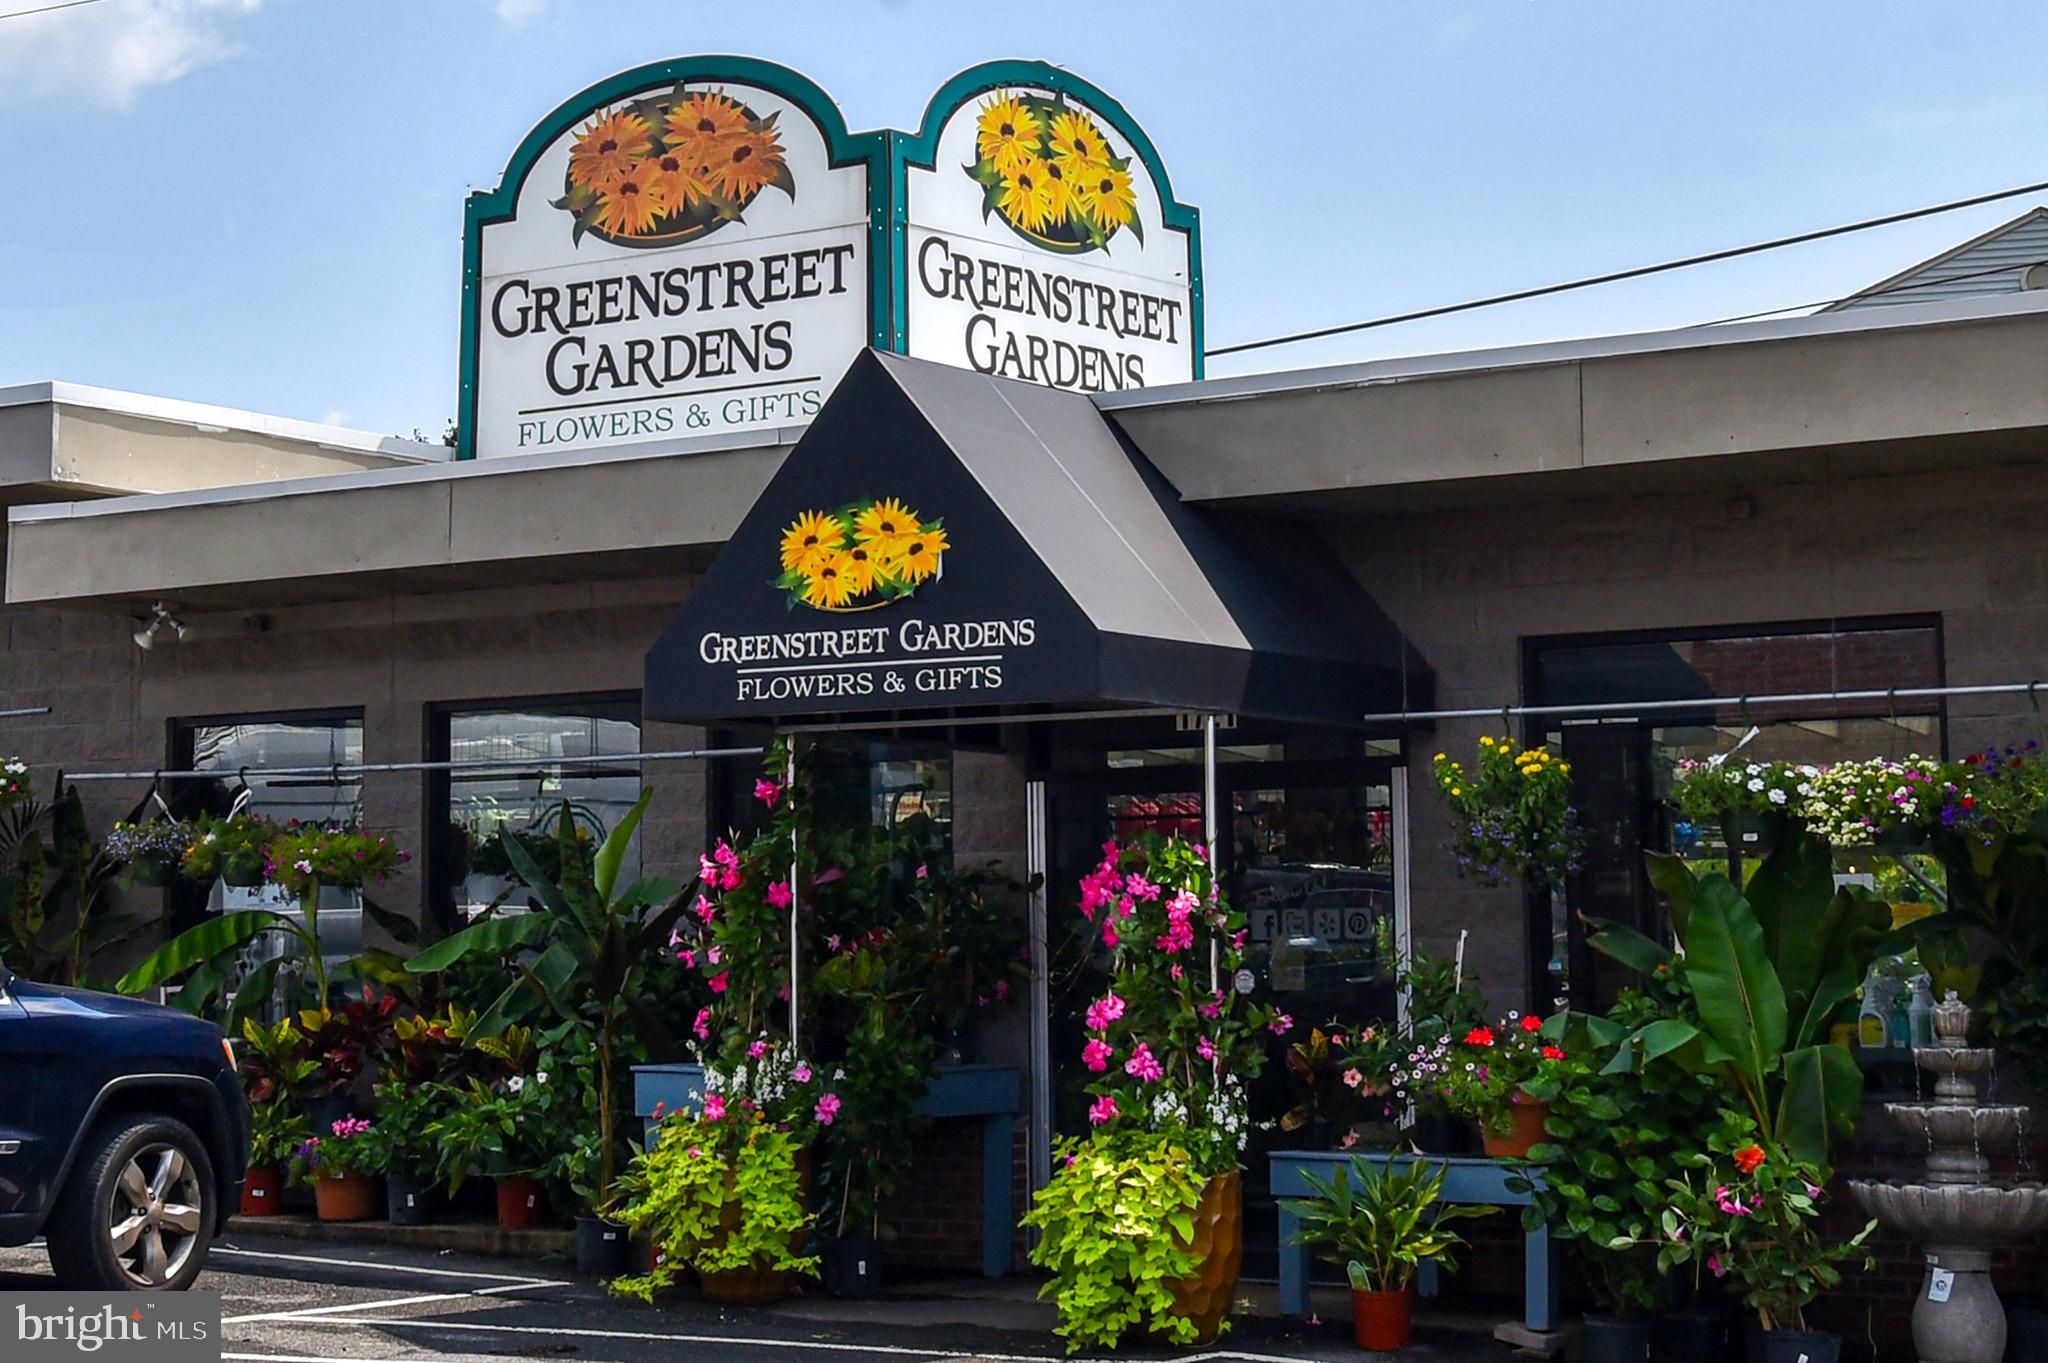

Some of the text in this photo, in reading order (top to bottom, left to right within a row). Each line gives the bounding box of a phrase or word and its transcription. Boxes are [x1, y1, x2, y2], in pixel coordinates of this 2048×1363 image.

[491, 243, 854, 338] GREENSTREET
[917, 236, 1182, 344] GREENSTREET
[545, 320, 793, 396] GARDENS
[965, 313, 1145, 392] GARDENS
[518, 390, 822, 447] FLOWERS & GIFTS
[700, 619, 1036, 664] GREENSTREET GARDENS
[737, 666, 1003, 701] FLOWERS & GIFTS
